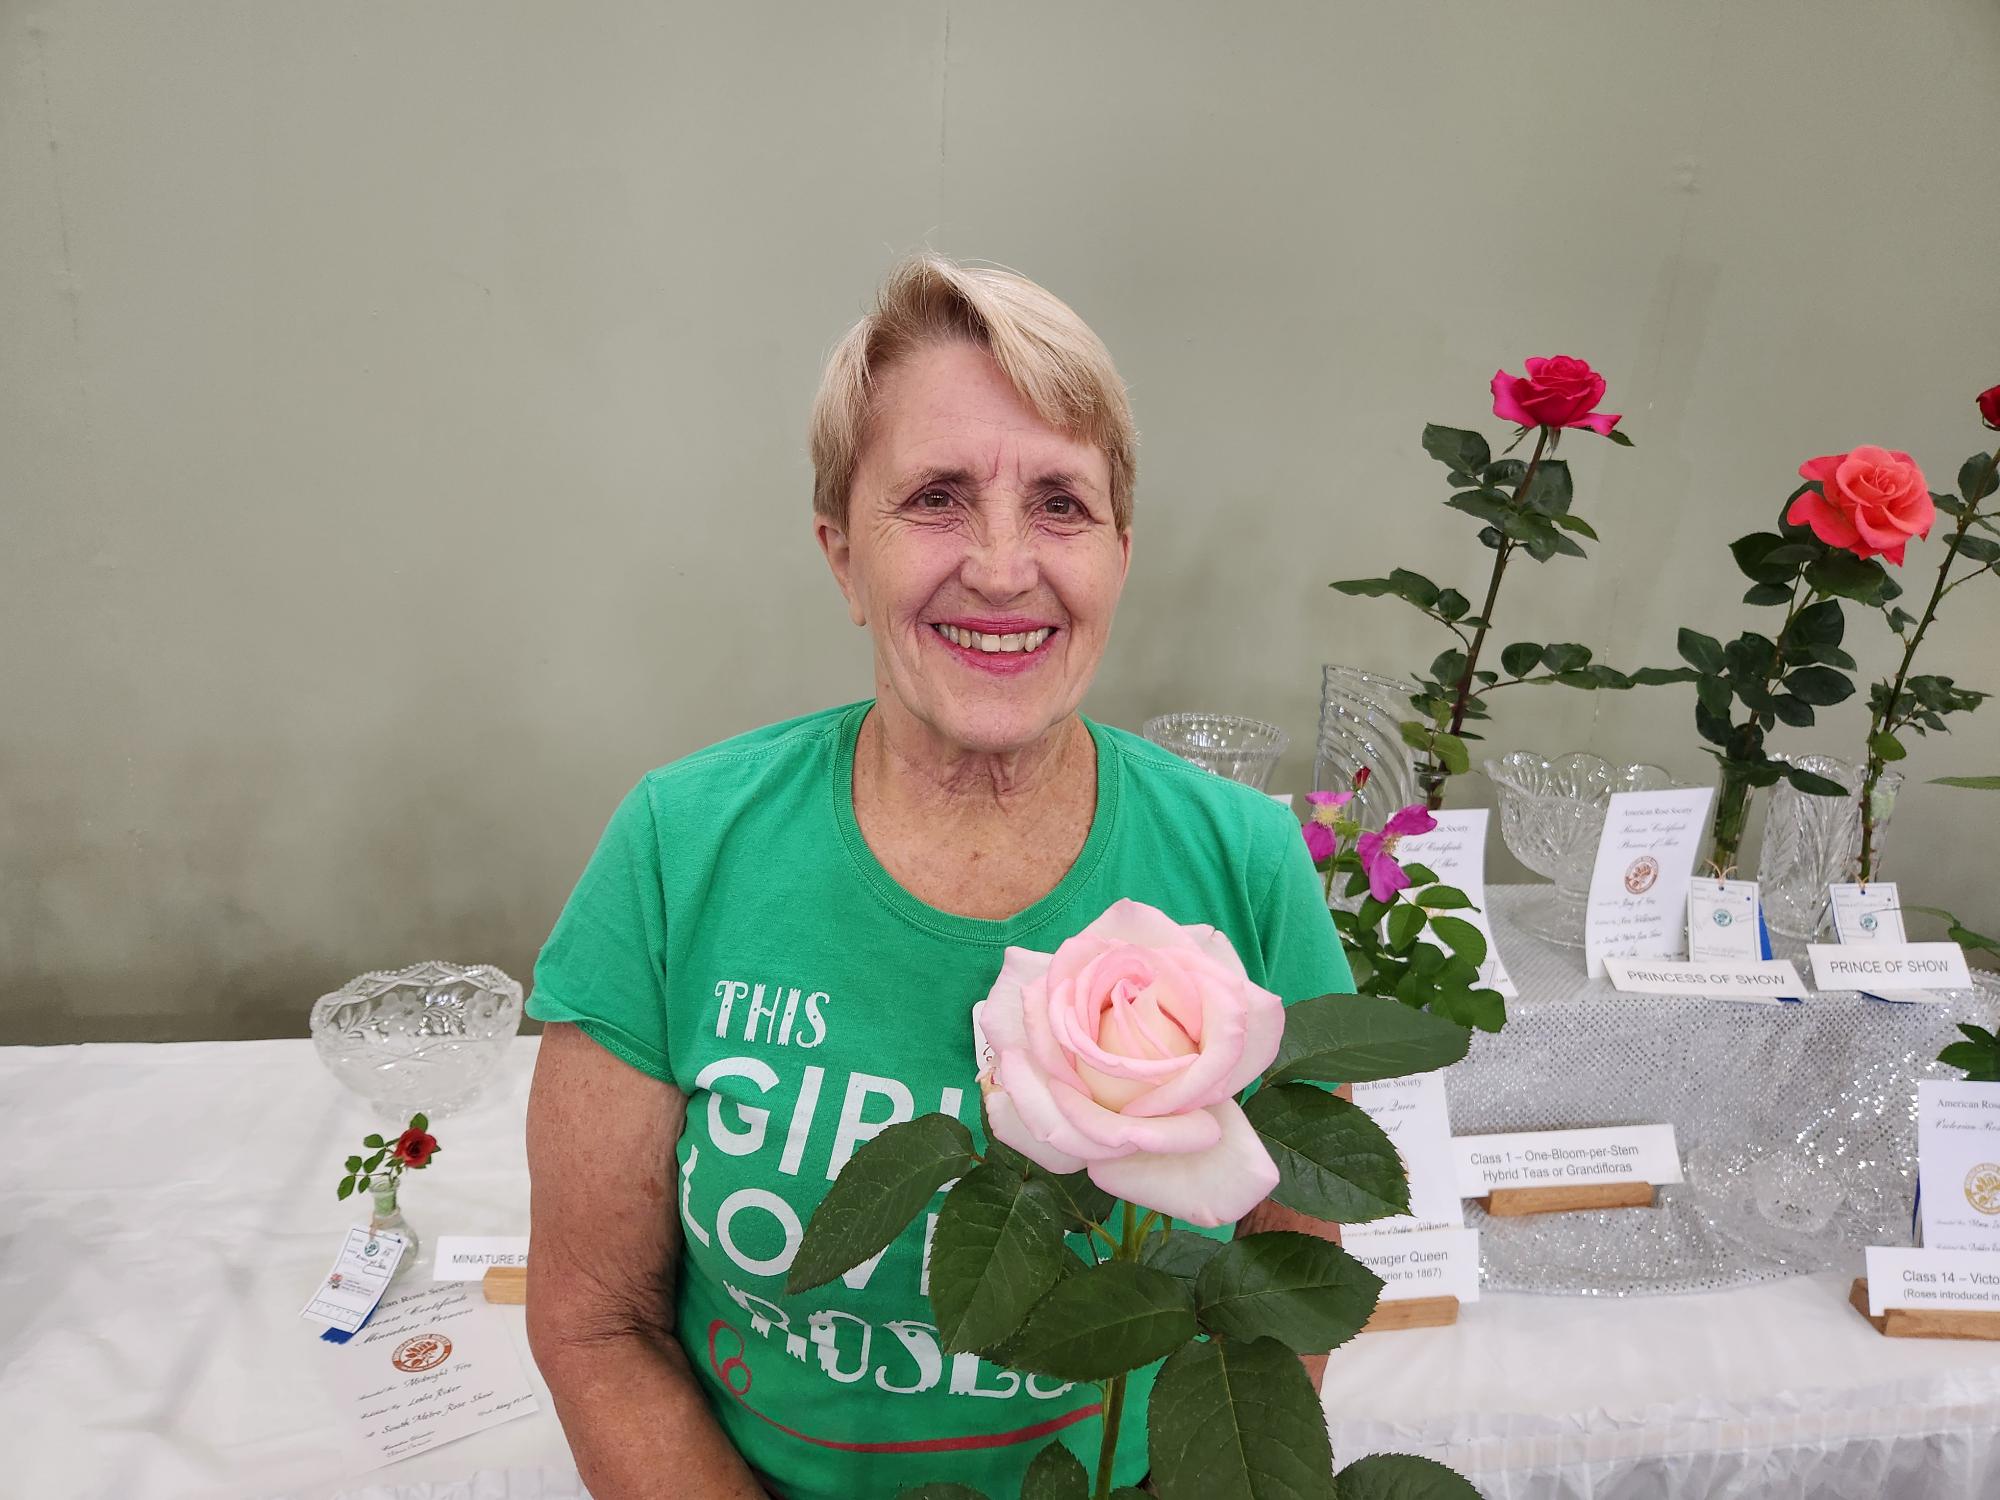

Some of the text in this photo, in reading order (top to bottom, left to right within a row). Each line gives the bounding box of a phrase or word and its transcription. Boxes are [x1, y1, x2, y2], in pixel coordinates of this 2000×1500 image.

[1829, 960, 1949, 974] PRINCE OF SHOW
[1626, 970, 1785, 985] PRINCESS OF SHOW
[713, 979, 830, 1049] THIS
[1371, 1081, 1391, 1090] Rose
[1393, 1078, 1422, 1088] Society
[1937, 1098, 1979, 1109] American
[695, 1056, 964, 1192] GIR
[1470, 1152, 1502, 1166] Class
[1505, 1152, 1511, 1163] 1
[1524, 1144, 1639, 1162] One-Bloom-per-Stem
[1482, 1161, 1633, 1184] Hybrid Teas or Grandifloras
[452, 1254, 515, 1265] MINIATURE
[1409, 1250, 1448, 1263] Queen
[1404, 1271, 1413, 1280] to
[1416, 1267, 1442, 1279] 1867)
[1902, 1270, 1937, 1284] Class
[1941, 1271, 1955, 1284] 14
[400, 1292, 426, 1304] Rose
[428, 1280, 465, 1295] Society
[1903, 1288, 1937, 1301] (Roses
[1939, 1289, 1989, 1301] introduced
[381, 1418, 410, 1434] South
